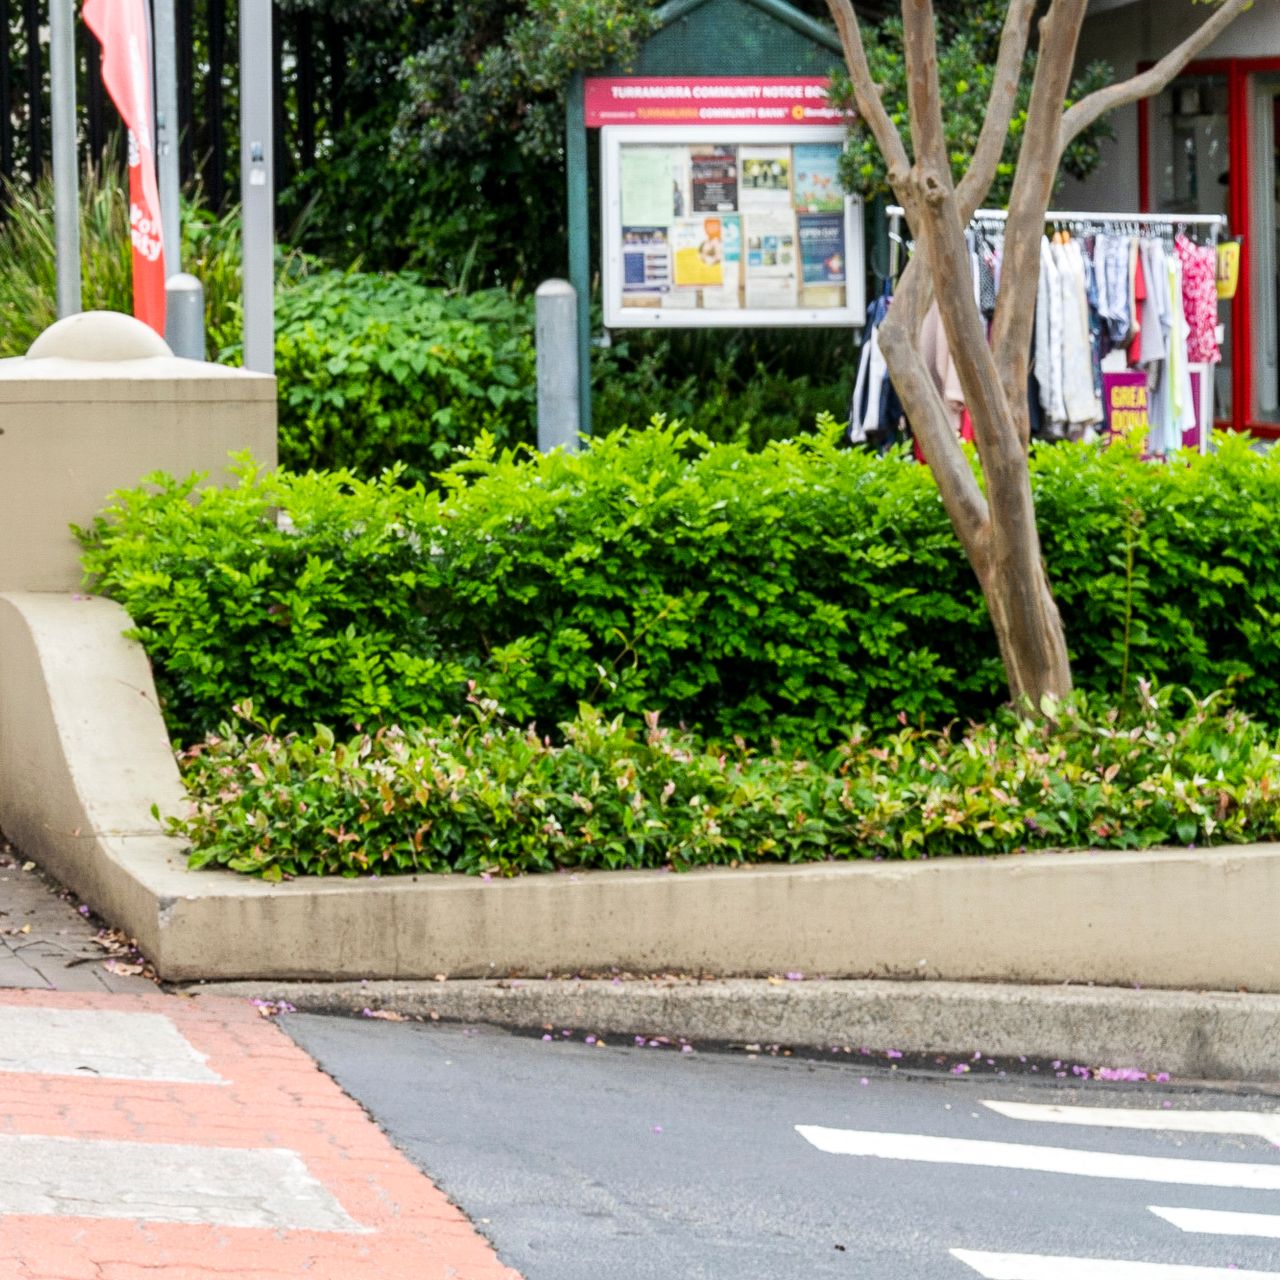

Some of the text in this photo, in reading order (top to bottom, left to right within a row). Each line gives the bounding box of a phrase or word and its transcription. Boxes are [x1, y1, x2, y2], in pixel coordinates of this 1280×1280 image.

[612, 86, 691, 98] TURRAMURRA
[692, 86, 761, 98] COMMUNITY
[762, 86, 803, 98] NOTICE
[699, 107, 756, 119] COMMUNITY
